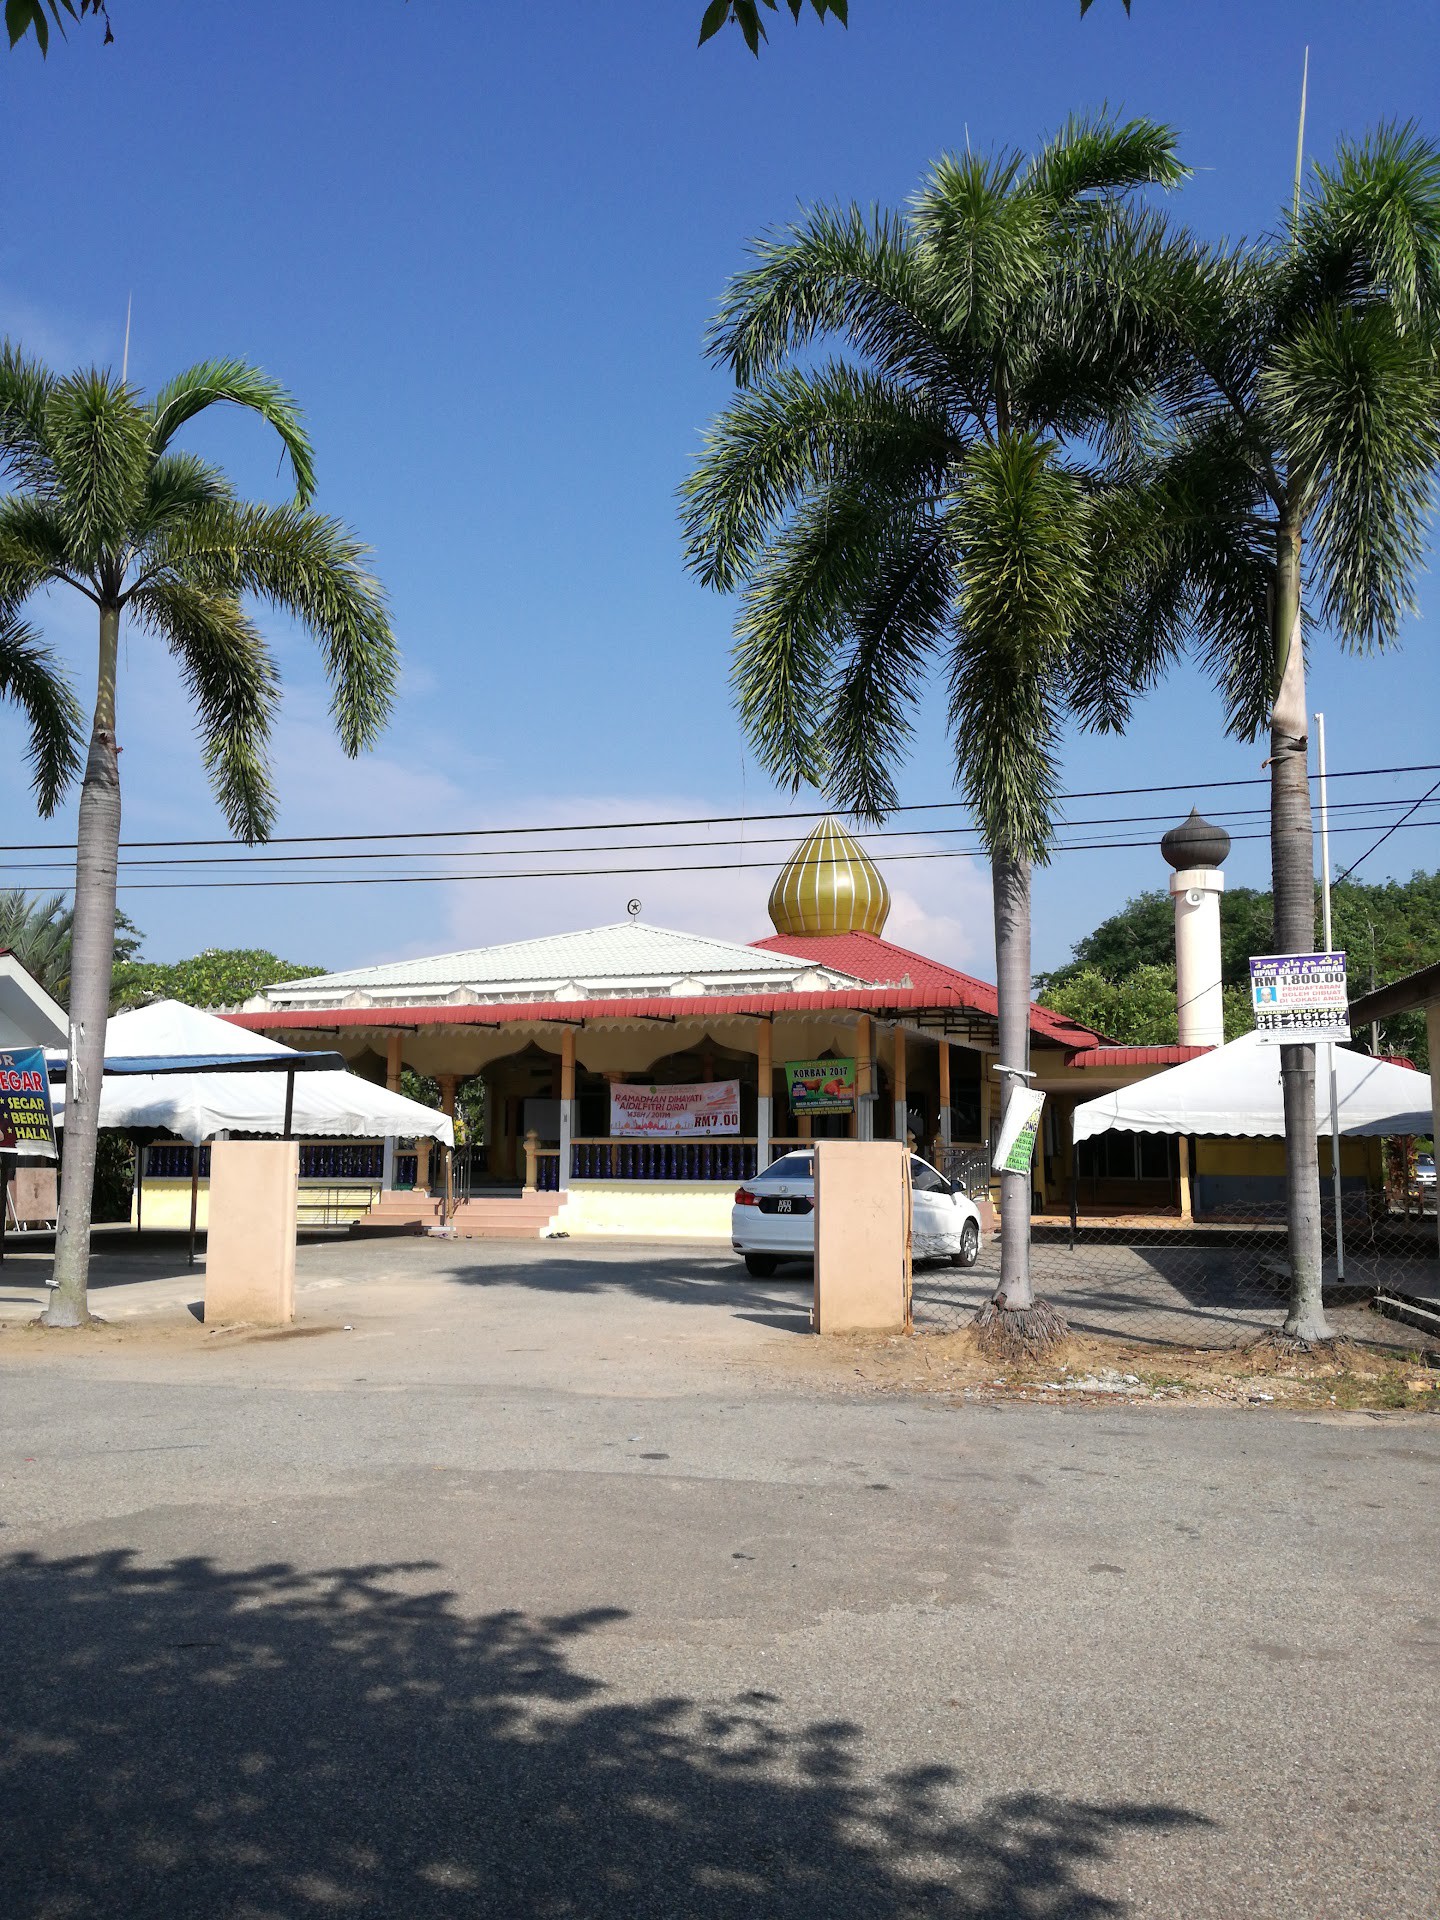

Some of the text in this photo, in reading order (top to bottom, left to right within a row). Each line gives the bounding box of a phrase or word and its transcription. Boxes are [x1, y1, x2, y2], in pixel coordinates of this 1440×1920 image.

[1253, 969, 1277, 977] UPAH
[1301, 966, 1309, 974] &
[1310, 965, 1344, 973] UMRAH
[1254, 972, 1345, 987] RM 1,800.00
[1282, 984, 1341, 992] PENDAFTARAN
[1256, 1011, 1346, 1023] 013-4161467
[1256, 1019, 1347, 1030] 013-4630926
[793, 1066, 848, 1078] KORBAN 2017
[7, 1097, 45, 1110] SEGAR
[614, 1094, 702, 1103] RAMADHAN DIHAYATI
[619, 1102, 665, 1111] AIDILFITRI
[11, 1112, 50, 1126] BERSIH
[694, 1113, 738, 1128] RM7.00
[15, 1126, 52, 1141] HALAL
[777, 1205, 792, 1213] 1773
